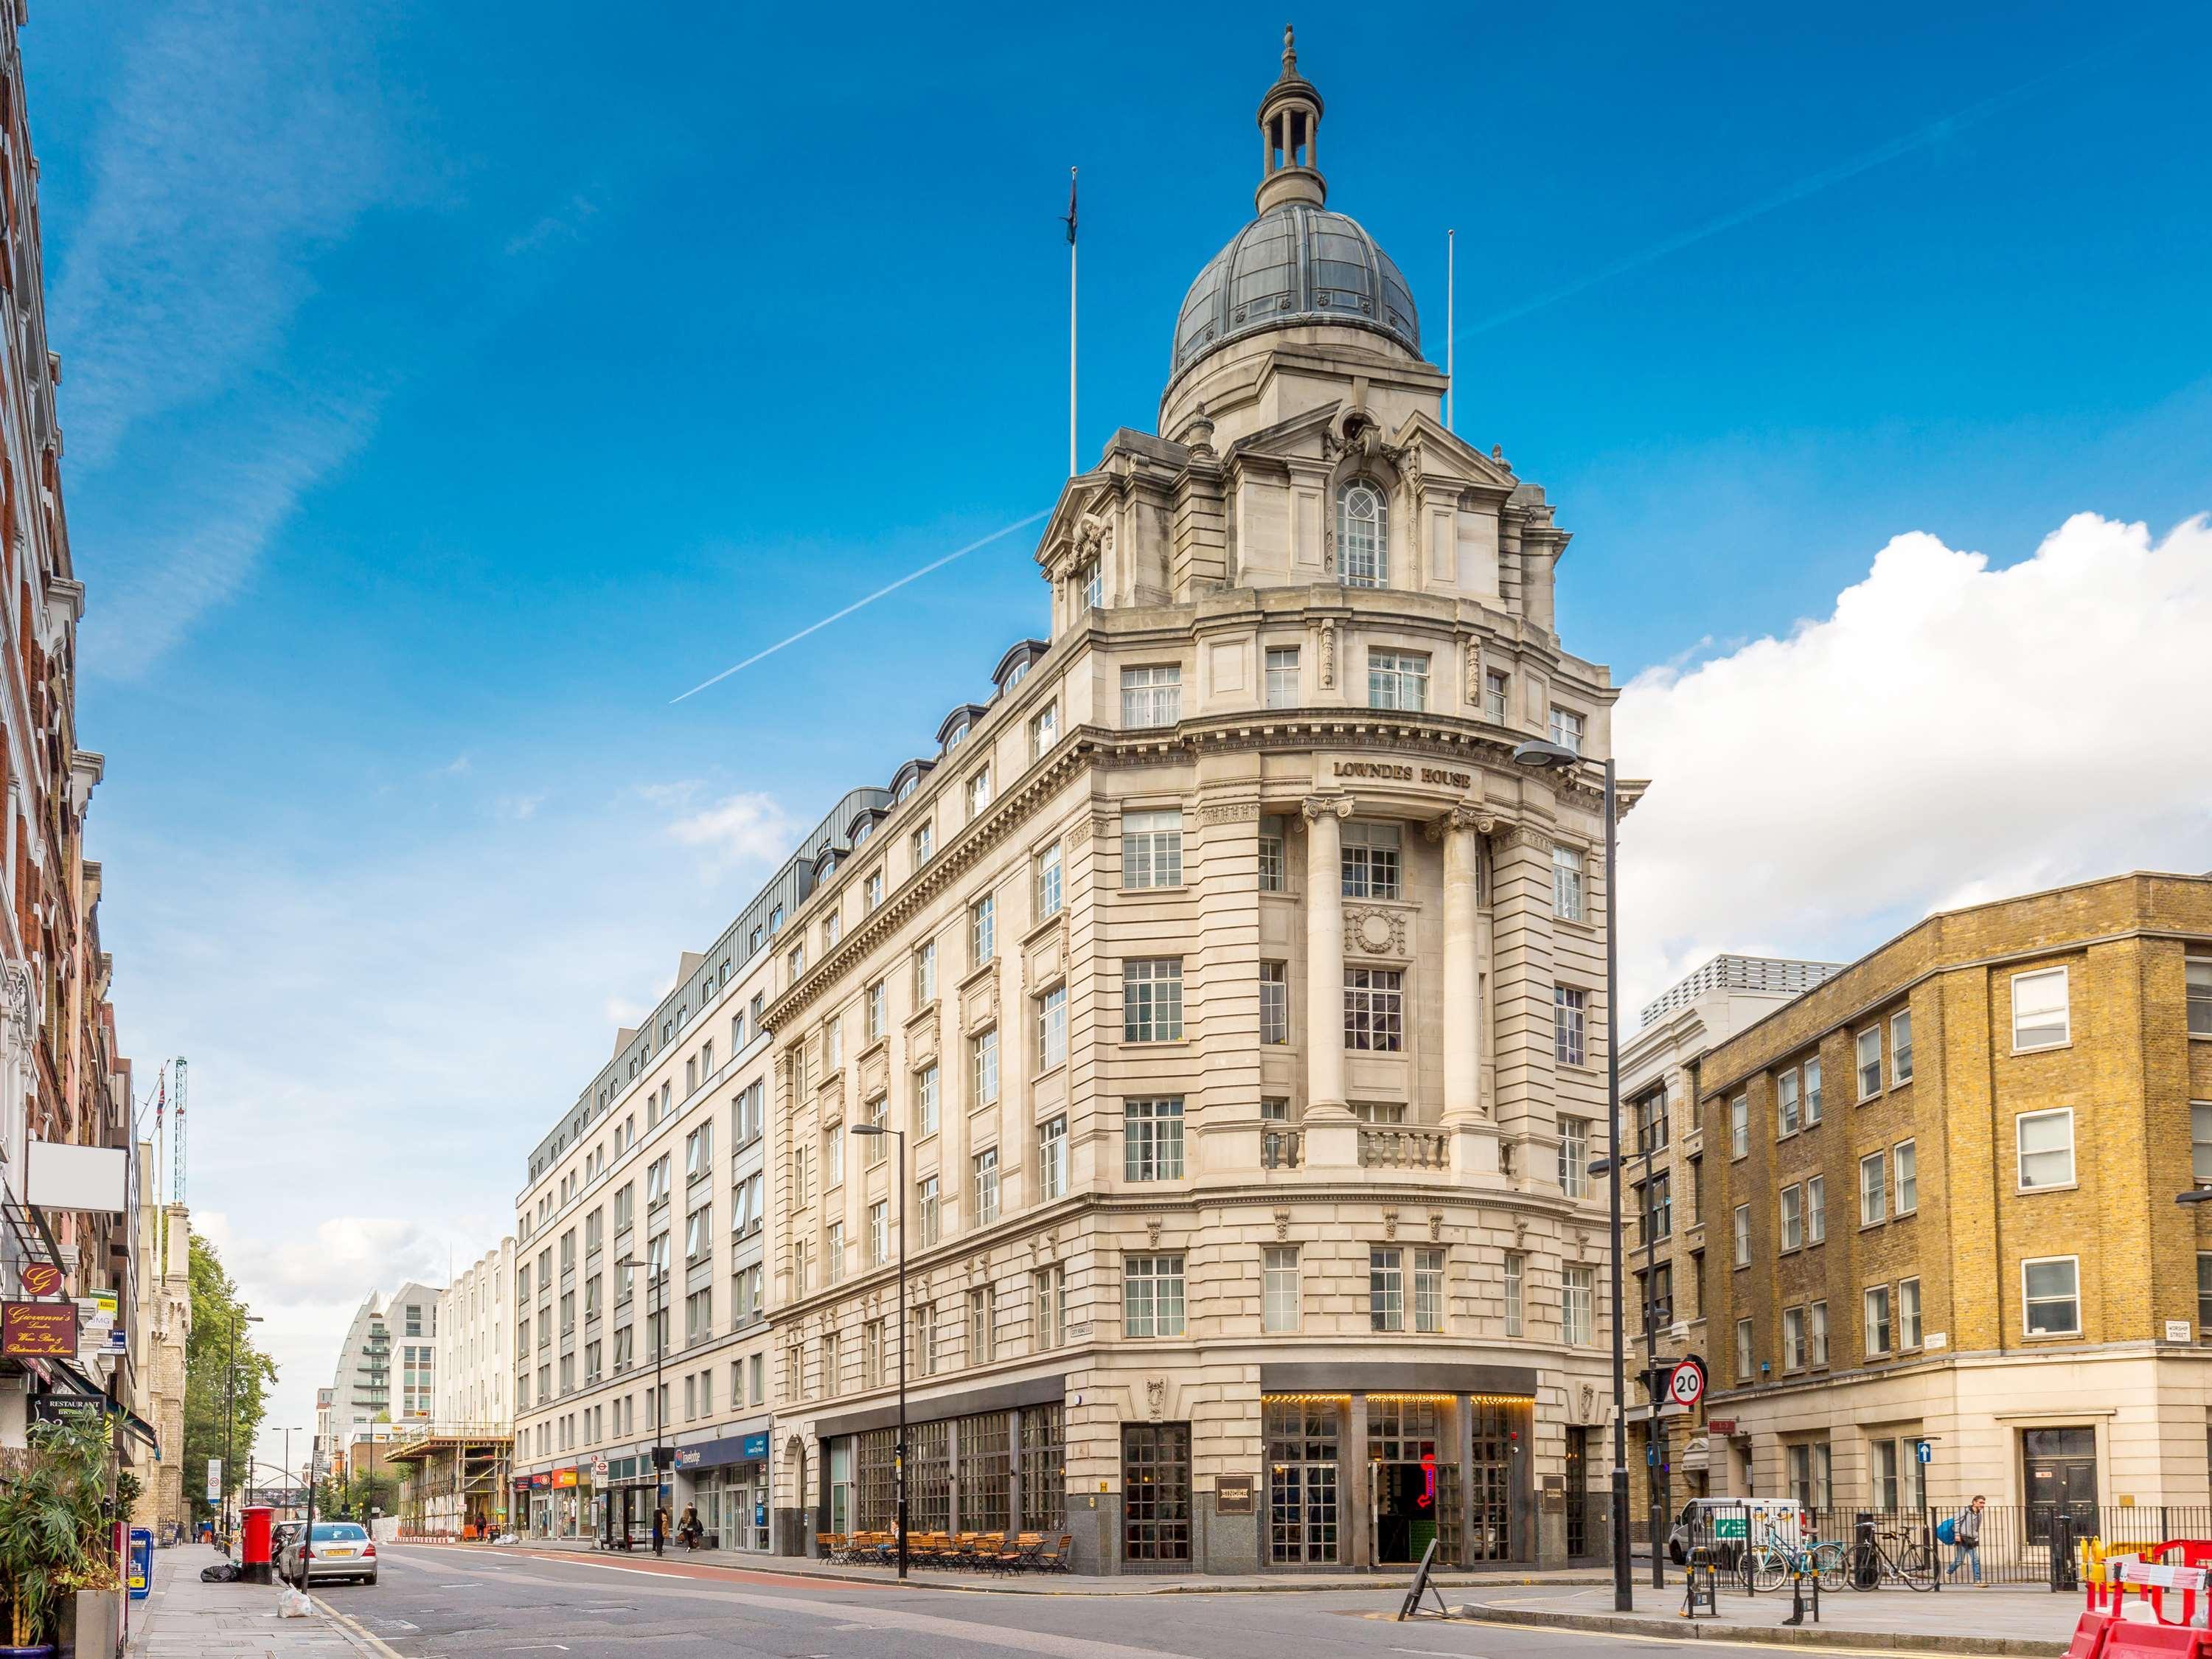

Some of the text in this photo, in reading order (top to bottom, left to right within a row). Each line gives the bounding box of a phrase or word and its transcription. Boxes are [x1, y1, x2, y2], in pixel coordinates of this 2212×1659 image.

[1333, 762, 1471, 789] LOWNDES HOUSE
[27, 1267, 58, 1293] G
[8, 1307, 71, 1324] Giovanni's
[27, 1321, 51, 1329] London
[18, 1332, 35, 1342] Wine
[38, 1332, 55, 1342] Bar
[1676, 1374, 1698, 1393] 20
[682, 1450, 700, 1465] Travelodge
[1221, 1489, 1248, 1498] SINGER
